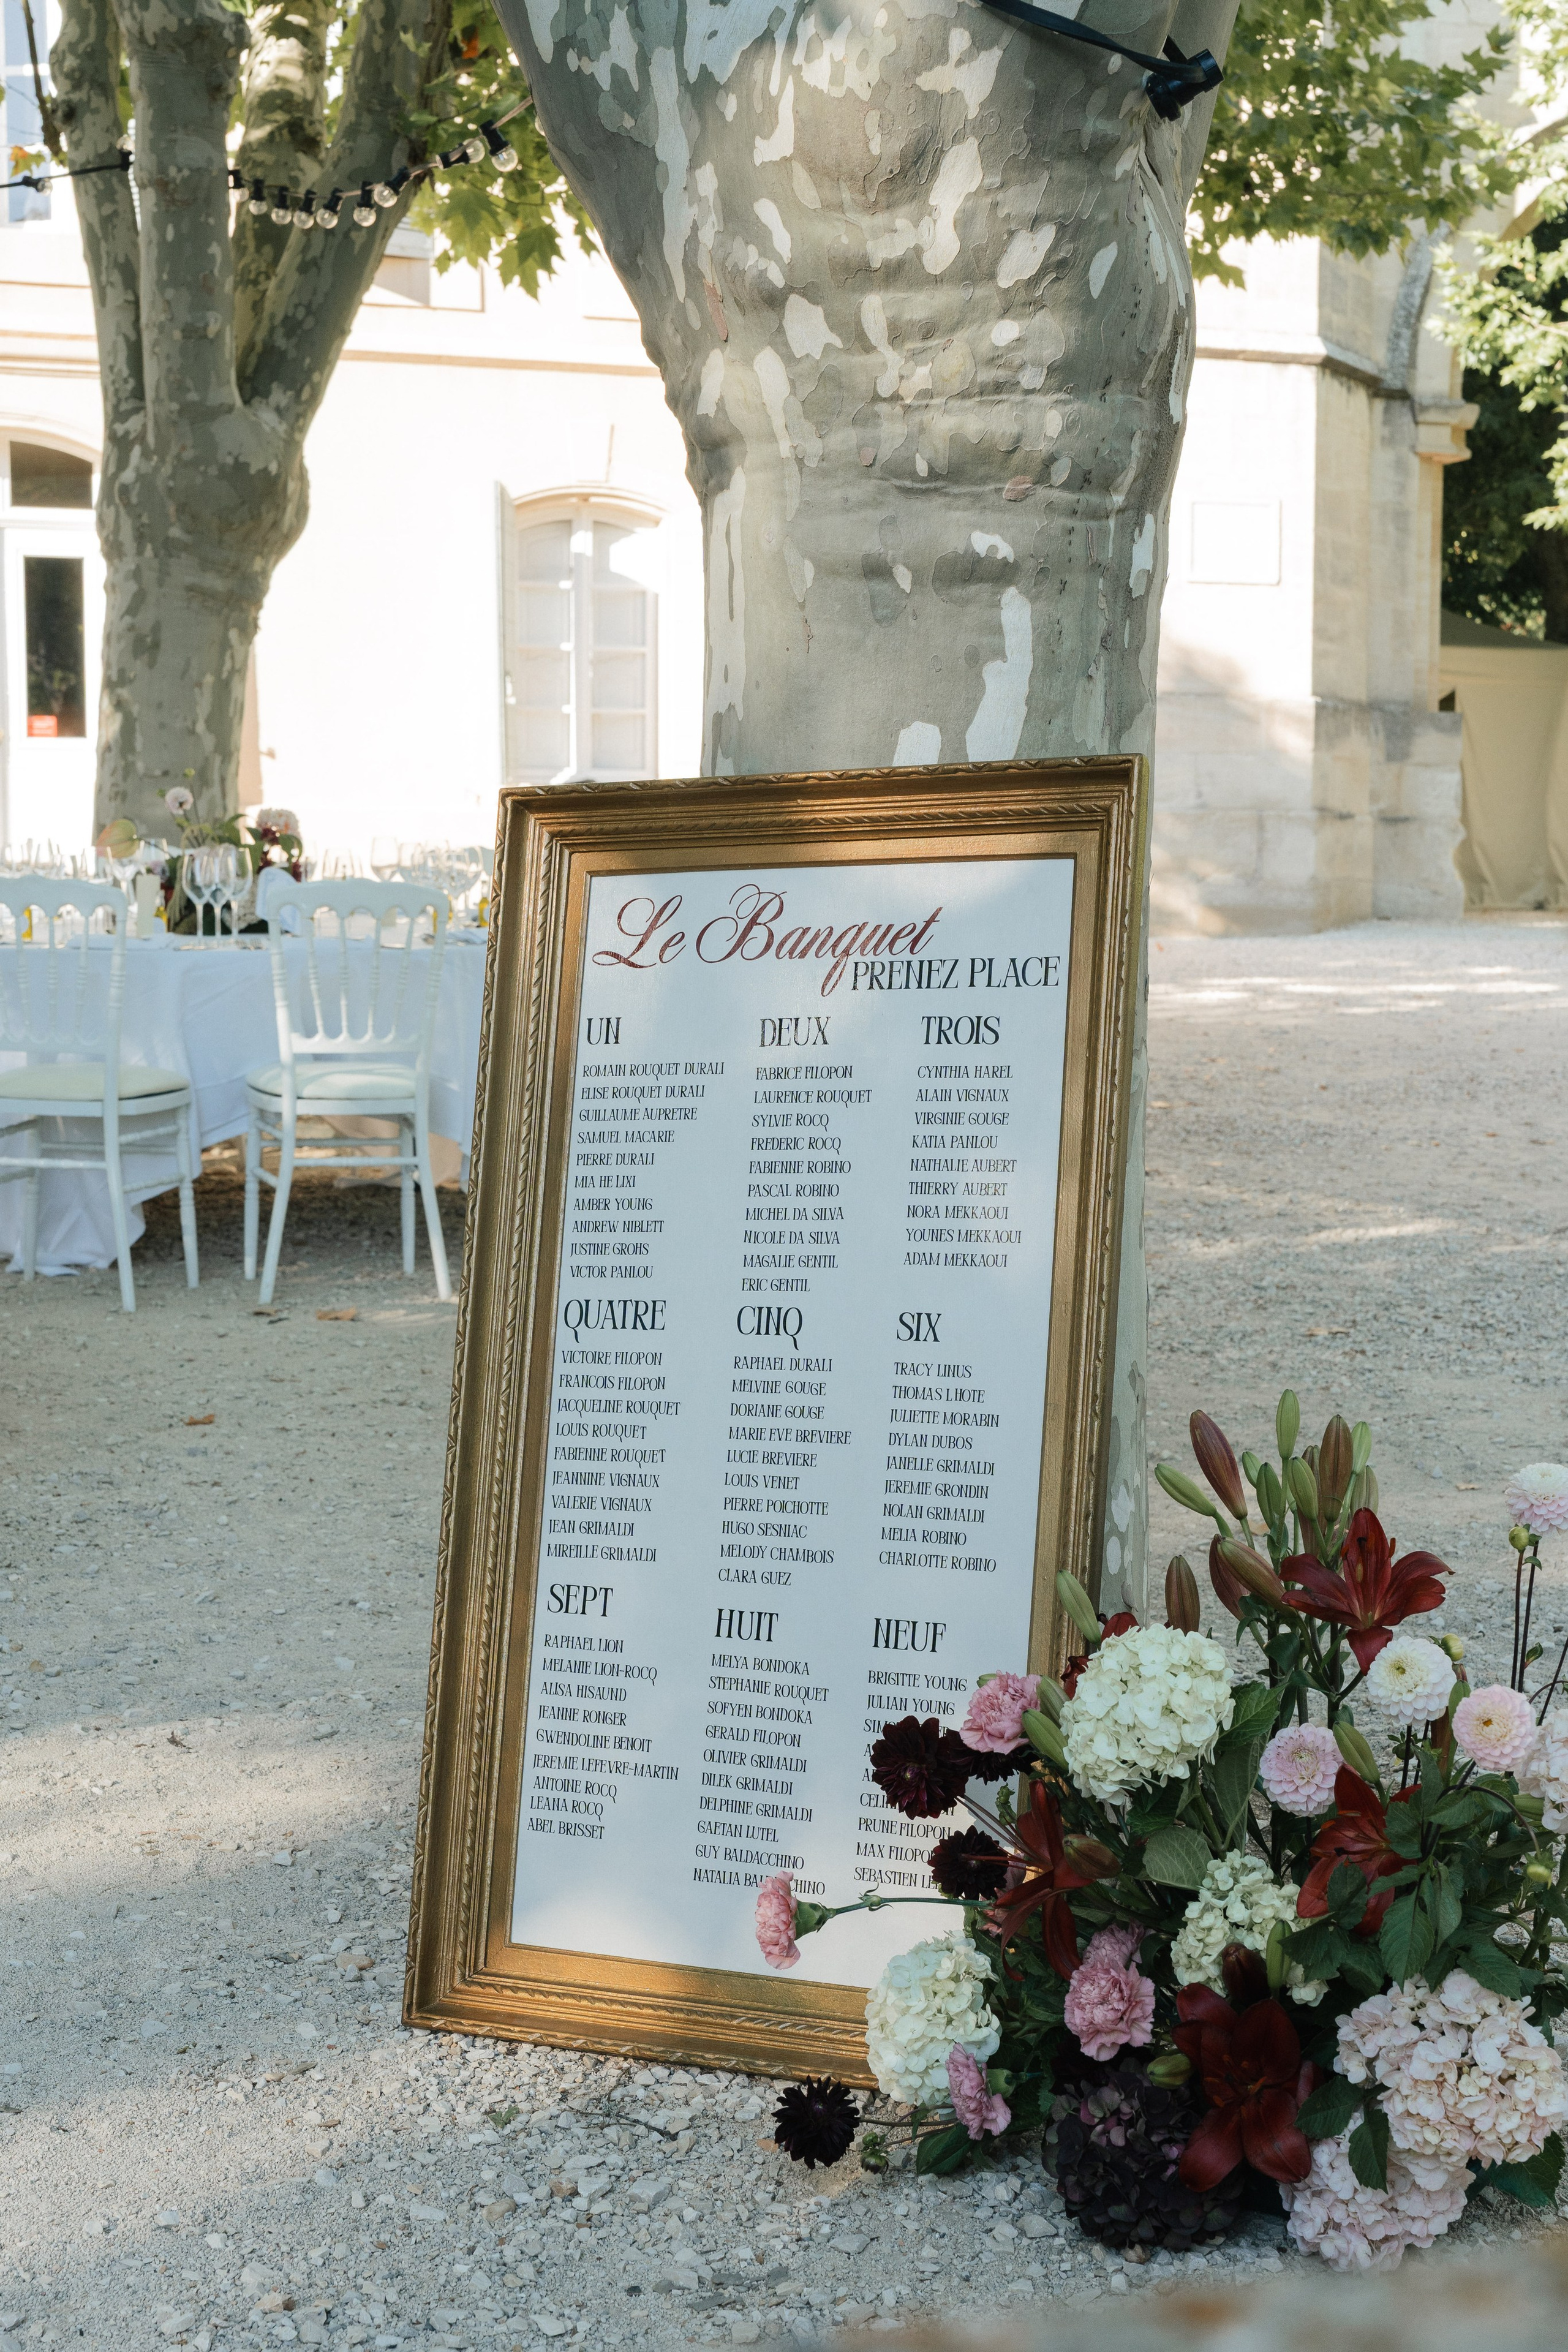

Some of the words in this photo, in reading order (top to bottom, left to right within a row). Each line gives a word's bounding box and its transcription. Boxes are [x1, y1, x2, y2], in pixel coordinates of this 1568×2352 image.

[592, 895, 687, 969] Le
[696, 884, 943, 997] Banquet
[851, 959, 959, 991] PRENEZ
[968, 956, 1061, 988] PLACE
[587, 1017, 621, 1045] UN
[760, 1016, 831, 1047] DEUX
[922, 1016, 1000, 1046] TROIS
[582, 1064, 626, 1077] ROMAIN
[630, 1063, 680, 1081] ROUQUET
[684, 1061, 725, 1075] DURALI
[918, 1065, 970, 1079] CYNTHIA
[974, 1065, 1013, 1079] HAREL
[754, 1090, 814, 1104] LAURENCE
[816, 1089, 872, 1108] ROUQUET
[916, 1088, 952, 1102] ALAIN
[956, 1088, 1009, 1102] VIGNAUX
[579, 1108, 640, 1121] GUILLAUME
[643, 1107, 698, 1120] AUPRETRE
[752, 1114, 793, 1128] SYLVIE
[796, 1113, 829, 1132] ROCQ
[914, 1112, 965, 1125] VIRGINIE
[968, 1112, 1009, 1125] GOUGE
[577, 1131, 621, 1144] SAMUEL
[625, 1130, 675, 1143] MACARIE
[751, 1137, 805, 1150] FREDERIC
[808, 1136, 841, 1155] ROCQ
[912, 1135, 946, 1148] KATIA
[950, 1135, 998, 1148] PANLOU
[576, 1153, 613, 1166] PIERRE
[616, 1153, 655, 1166] DURALI
[749, 1161, 804, 1174] FABIENNE
[807, 1160, 851, 1174] ROBINO
[575, 1175, 595, 1188] MIA
[599, 1175, 613, 1188] HE
[616, 1175, 636, 1188] LIXI
[747, 1183, 792, 1197] PASCAL
[796, 1184, 840, 1197] ROBINO
[573, 1198, 611, 1211] AMBER
[614, 1197, 653, 1210] YOUNG
[907, 1205, 940, 1218] NORA
[944, 1205, 1008, 1219] MEKKAOUI
[745, 1207, 790, 1221] MICHEL
[793, 1207, 808, 1221] DA
[812, 1207, 844, 1221] SILVA
[572, 1220, 619, 1233] ANDREW
[622, 1220, 665, 1233] NIBLETT
[905, 1228, 954, 1242] YOUNES
[957, 1229, 1022, 1243] MEKKAOUI
[570, 1243, 611, 1257] JUSTINE
[612, 1242, 649, 1256] GROHS
[743, 1254, 796, 1268] MAGALIE
[798, 1254, 839, 1268] GENTIL
[903, 1252, 940, 1266] ADAM
[944, 1253, 1008, 1267] MEKKAOUI
[570, 1265, 607, 1278] VICTOR
[611, 1265, 654, 1278] PANLOU
[742, 1278, 768, 1291] ERIC
[770, 1278, 810, 1292] GENTIL
[564, 1300, 666, 1343] QUATRE
[737, 1306, 804, 1351] CINQ
[897, 1312, 943, 1343] SIX
[562, 1350, 612, 1365] VICTOIRE
[614, 1351, 663, 1366] FILOPON
[734, 1356, 786, 1371] RAPHAEL
[790, 1358, 832, 1372] DURALI
[894, 1362, 933, 1376] TRACY
[937, 1363, 972, 1378] LINUS
[559, 1374, 615, 1389] FRANCOIS
[618, 1376, 666, 1391] FILOPON
[732, 1379, 781, 1394] MELVINE
[785, 1381, 826, 1396] GOUGE
[557, 1398, 623, 1418] JACQUELINE
[626, 1400, 681, 1420] ROUQUET
[890, 1409, 940, 1424] JULIETTE
[943, 1411, 1000, 1428] MORABIN
[556, 1422, 589, 1436] LOUIS
[592, 1423, 647, 1443] ROUQUET
[729, 1427, 767, 1441] MARIE
[769, 1428, 793, 1442] EVE
[795, 1429, 852, 1445] BREVIERE
[888, 1432, 928, 1447] DYLAN
[932, 1434, 973, 1450] DUBOS
[727, 1449, 759, 1463] LUCIE
[761, 1450, 817, 1468] BREVIERE
[886, 1456, 934, 1472] JANELLE
[937, 1459, 995, 1476] GRIMALDI
[552, 1471, 606, 1486] JEANNINE
[609, 1473, 660, 1488] VIGNAUX
[725, 1472, 758, 1488] LOUIS
[763, 1475, 800, 1490] VENET
[884, 1479, 932, 1495] JEREMIE
[935, 1483, 989, 1499] GRONDIN
[723, 1497, 763, 1512] PIERRE
[766, 1499, 829, 1515] POICHOTTE
[549, 1519, 576, 1534] JEAN
[579, 1521, 635, 1537] GRIMALDI
[722, 1520, 755, 1536] HUGO
[757, 1523, 807, 1539] SESNIAC
[881, 1527, 917, 1542] MELIA
[922, 1529, 967, 1545] ROBINO
[547, 1544, 599, 1558] MIREILLE
[600, 1546, 657, 1562] GRIMALDI
[720, 1544, 767, 1559] MELODY
[770, 1547, 834, 1564] CHAMBOIS
[879, 1551, 948, 1569] CHARLOTTE
[951, 1556, 997, 1572] ROBINO
[718, 1568, 757, 1584] CLARA
[761, 1571, 791, 1586] GUEZ
[547, 1583, 614, 1618] SEPT
[715, 1608, 779, 1643] HUIT
[544, 1634, 595, 1651] RAPHAEL
[598, 1638, 624, 1653] LION
[872, 1618, 946, 1653] NEUF
[543, 1657, 592, 1675] MELANIE
[594, 1662, 657, 1686] LION-ROCQ
[711, 1653, 748, 1670] MELYA
[753, 1657, 810, 1675] BONDOKA
[709, 1676, 771, 1695] STEPHANIE
[774, 1683, 829, 1705] ROUQUET
[868, 1670, 921, 1687] BRIGITTE
[924, 1675, 967, 1692] YOUNG
[541, 1681, 572, 1697] ALISA
[576, 1684, 627, 1702] HISAUND
[707, 1701, 753, 1717] SOFYEN
[755, 1705, 813, 1724] BONDOKA
[867, 1694, 908, 1711] JULIAN
[912, 1698, 955, 1715] YOUNG
[538, 1705, 579, 1722] JEANNE
[582, 1709, 627, 1726] RONGER
[536, 1728, 611, 1749] GWENDOLINE
[613, 1736, 652, 1752] BENOIT
[705, 1725, 750, 1742] GERALD
[753, 1728, 801, 1747] FILOPON
[533, 1754, 579, 1770] JEREMIE
[581, 1757, 679, 1781] LEFEVRE-MARTIN
[703, 1749, 747, 1766] OLIVIER
[750, 1754, 807, 1773] GRIMALDI
[533, 1776, 582, 1793] ANTOINE
[584, 1781, 617, 1804] ROCQ
[701, 1772, 733, 1789] DILEK
[736, 1776, 793, 1795] GRIMALDI
[527, 1817, 555, 1834] ABEL
[558, 1821, 605, 1839] BRISSET
[697, 1820, 743, 1838] GAETAN
[745, 1825, 778, 1842] LUTEL
[858, 1817, 897, 1834] PRUNE
[899, 1823, 951, 1839] FILOPON
[695, 1844, 720, 1859] GUY
[724, 1847, 804, 1869] BALDACCHINO
[854, 1866, 918, 1887] SEBASTIEN
